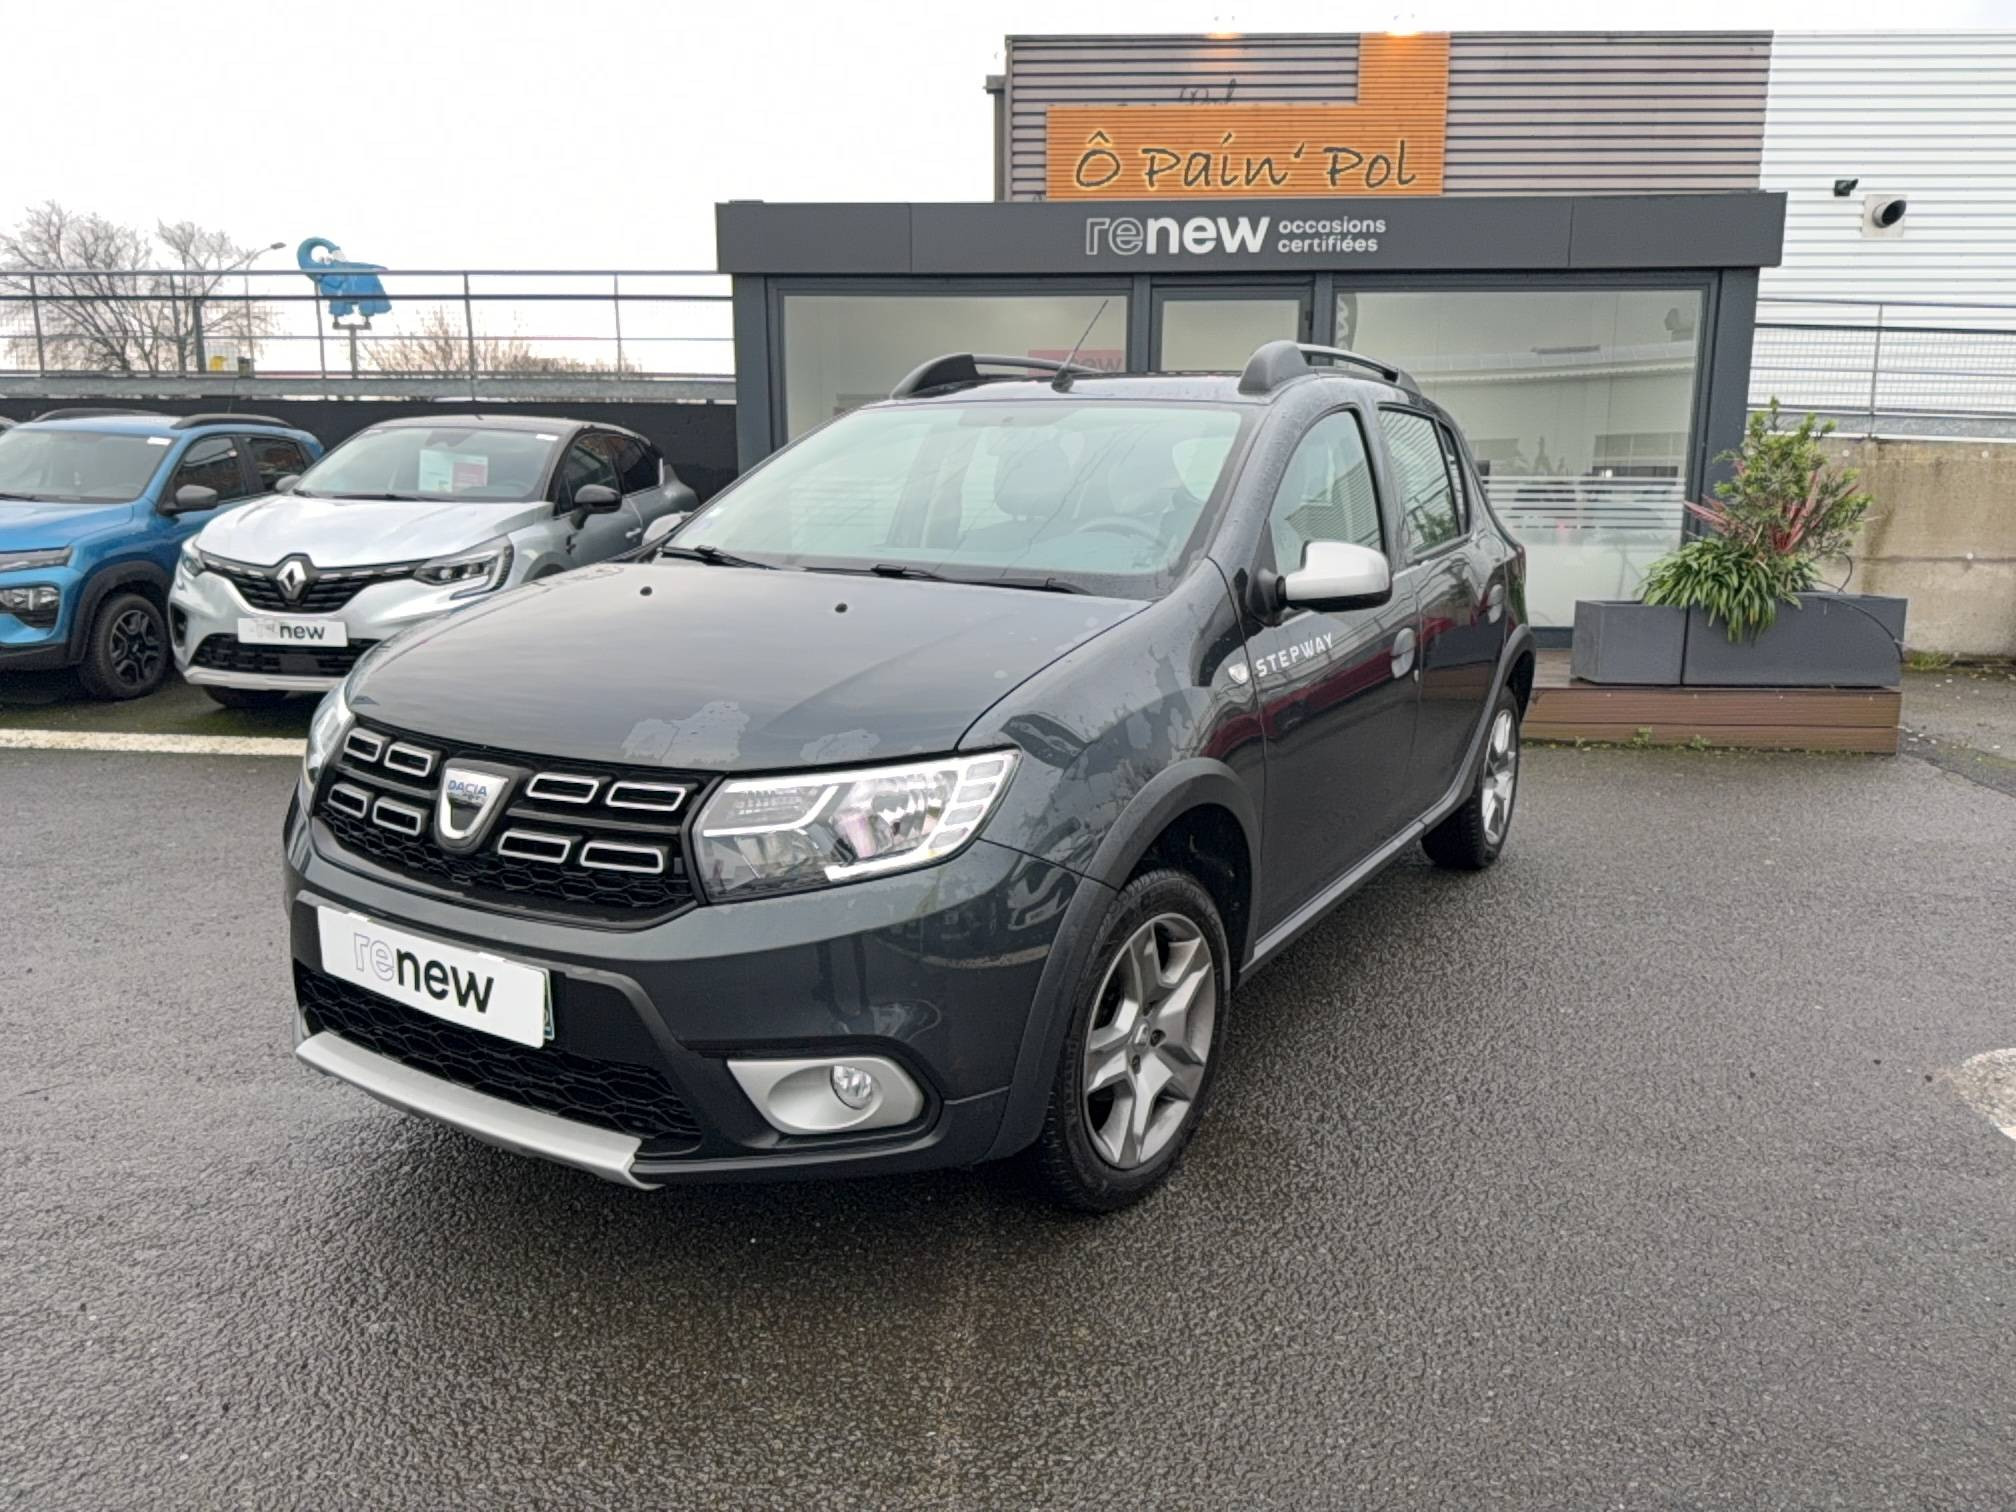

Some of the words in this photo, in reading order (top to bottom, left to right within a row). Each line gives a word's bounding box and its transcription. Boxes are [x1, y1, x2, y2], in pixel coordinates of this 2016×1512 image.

[1075, 130, 1121, 188] Ô
[1323, 139, 1416, 188] Pol
[1085, 215, 1271, 256] renew
[1277, 235, 1379, 254] certifiées
[1278, 215, 1387, 235] occasions
[1255, 632, 1333, 678] STEPWAY
[447, 779, 488, 797] DACIA
[353, 932, 495, 1014] renew
